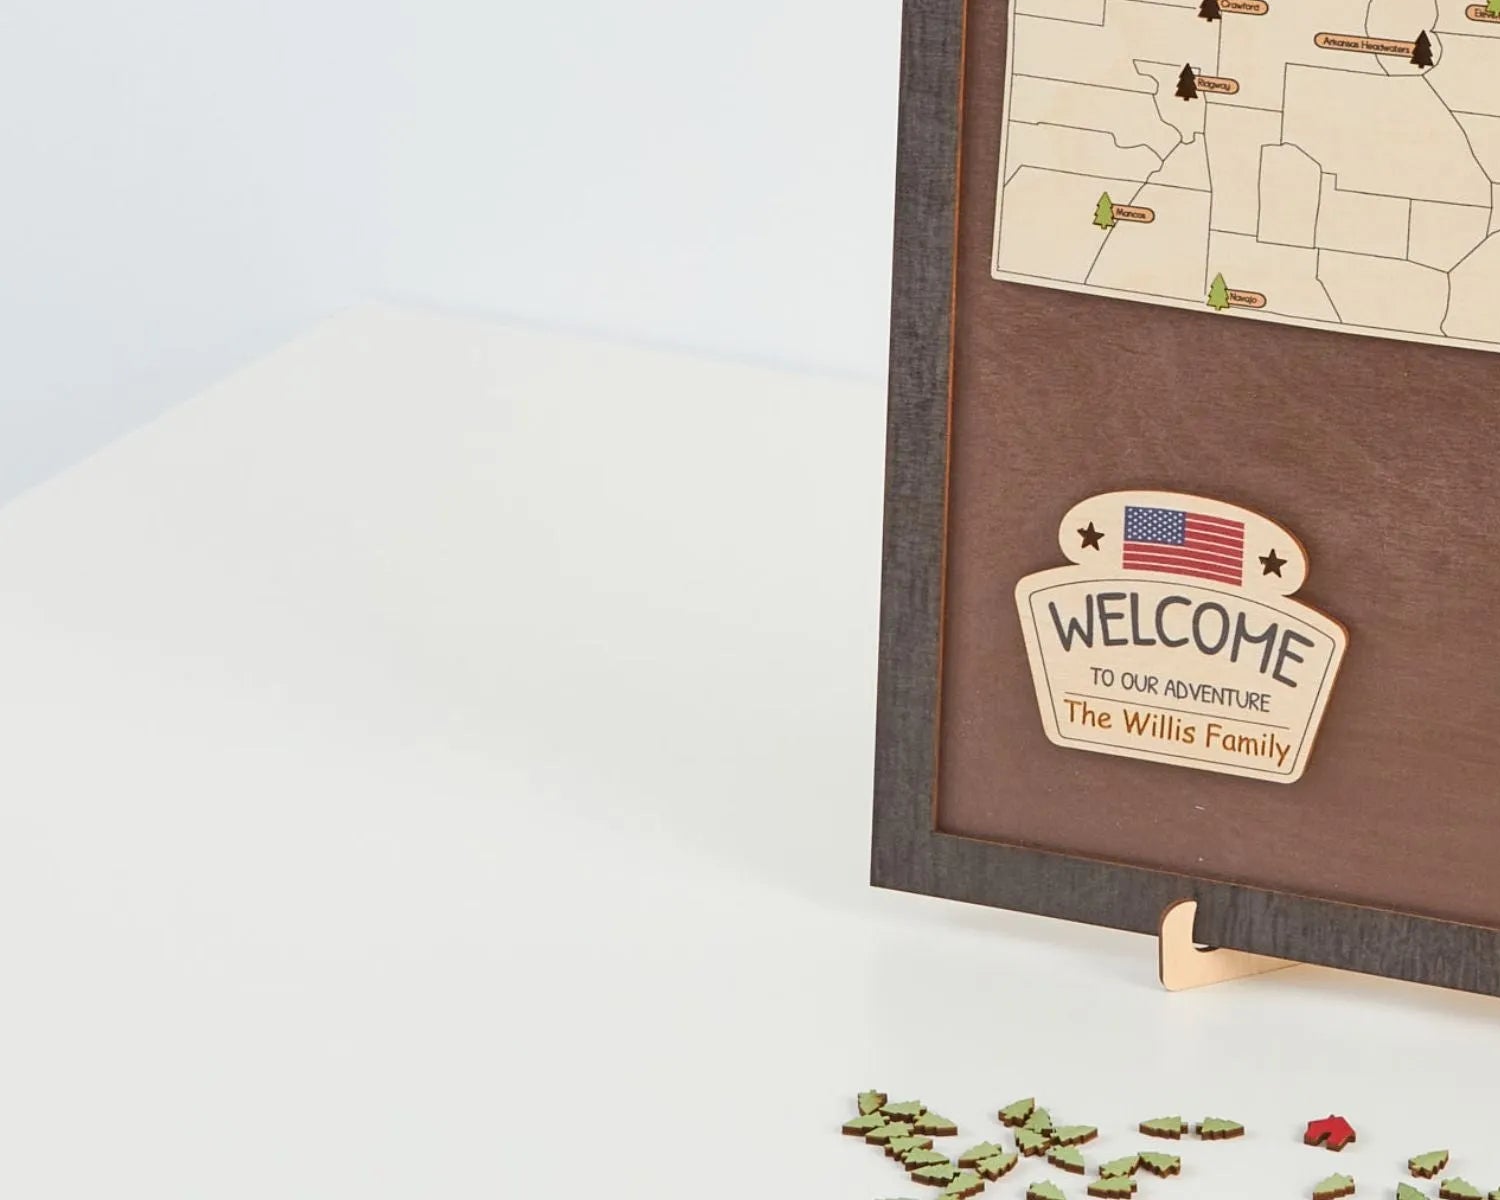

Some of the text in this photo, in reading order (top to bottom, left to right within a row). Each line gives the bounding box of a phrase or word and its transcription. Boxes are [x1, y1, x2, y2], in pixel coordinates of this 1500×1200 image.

[1220, 0, 1260, 11] Crawford
[1323, 37, 1410, 54] Arkansas Headwaters
[1116, 208, 1146, 219] Mancos
[1230, 293, 1257, 305] Navajo
[1048, 592, 1315, 688] WELCOME
[1091, 667, 1272, 713] TO OUR ADVENTURE
[1063, 699, 1291, 767] The Willis Family
